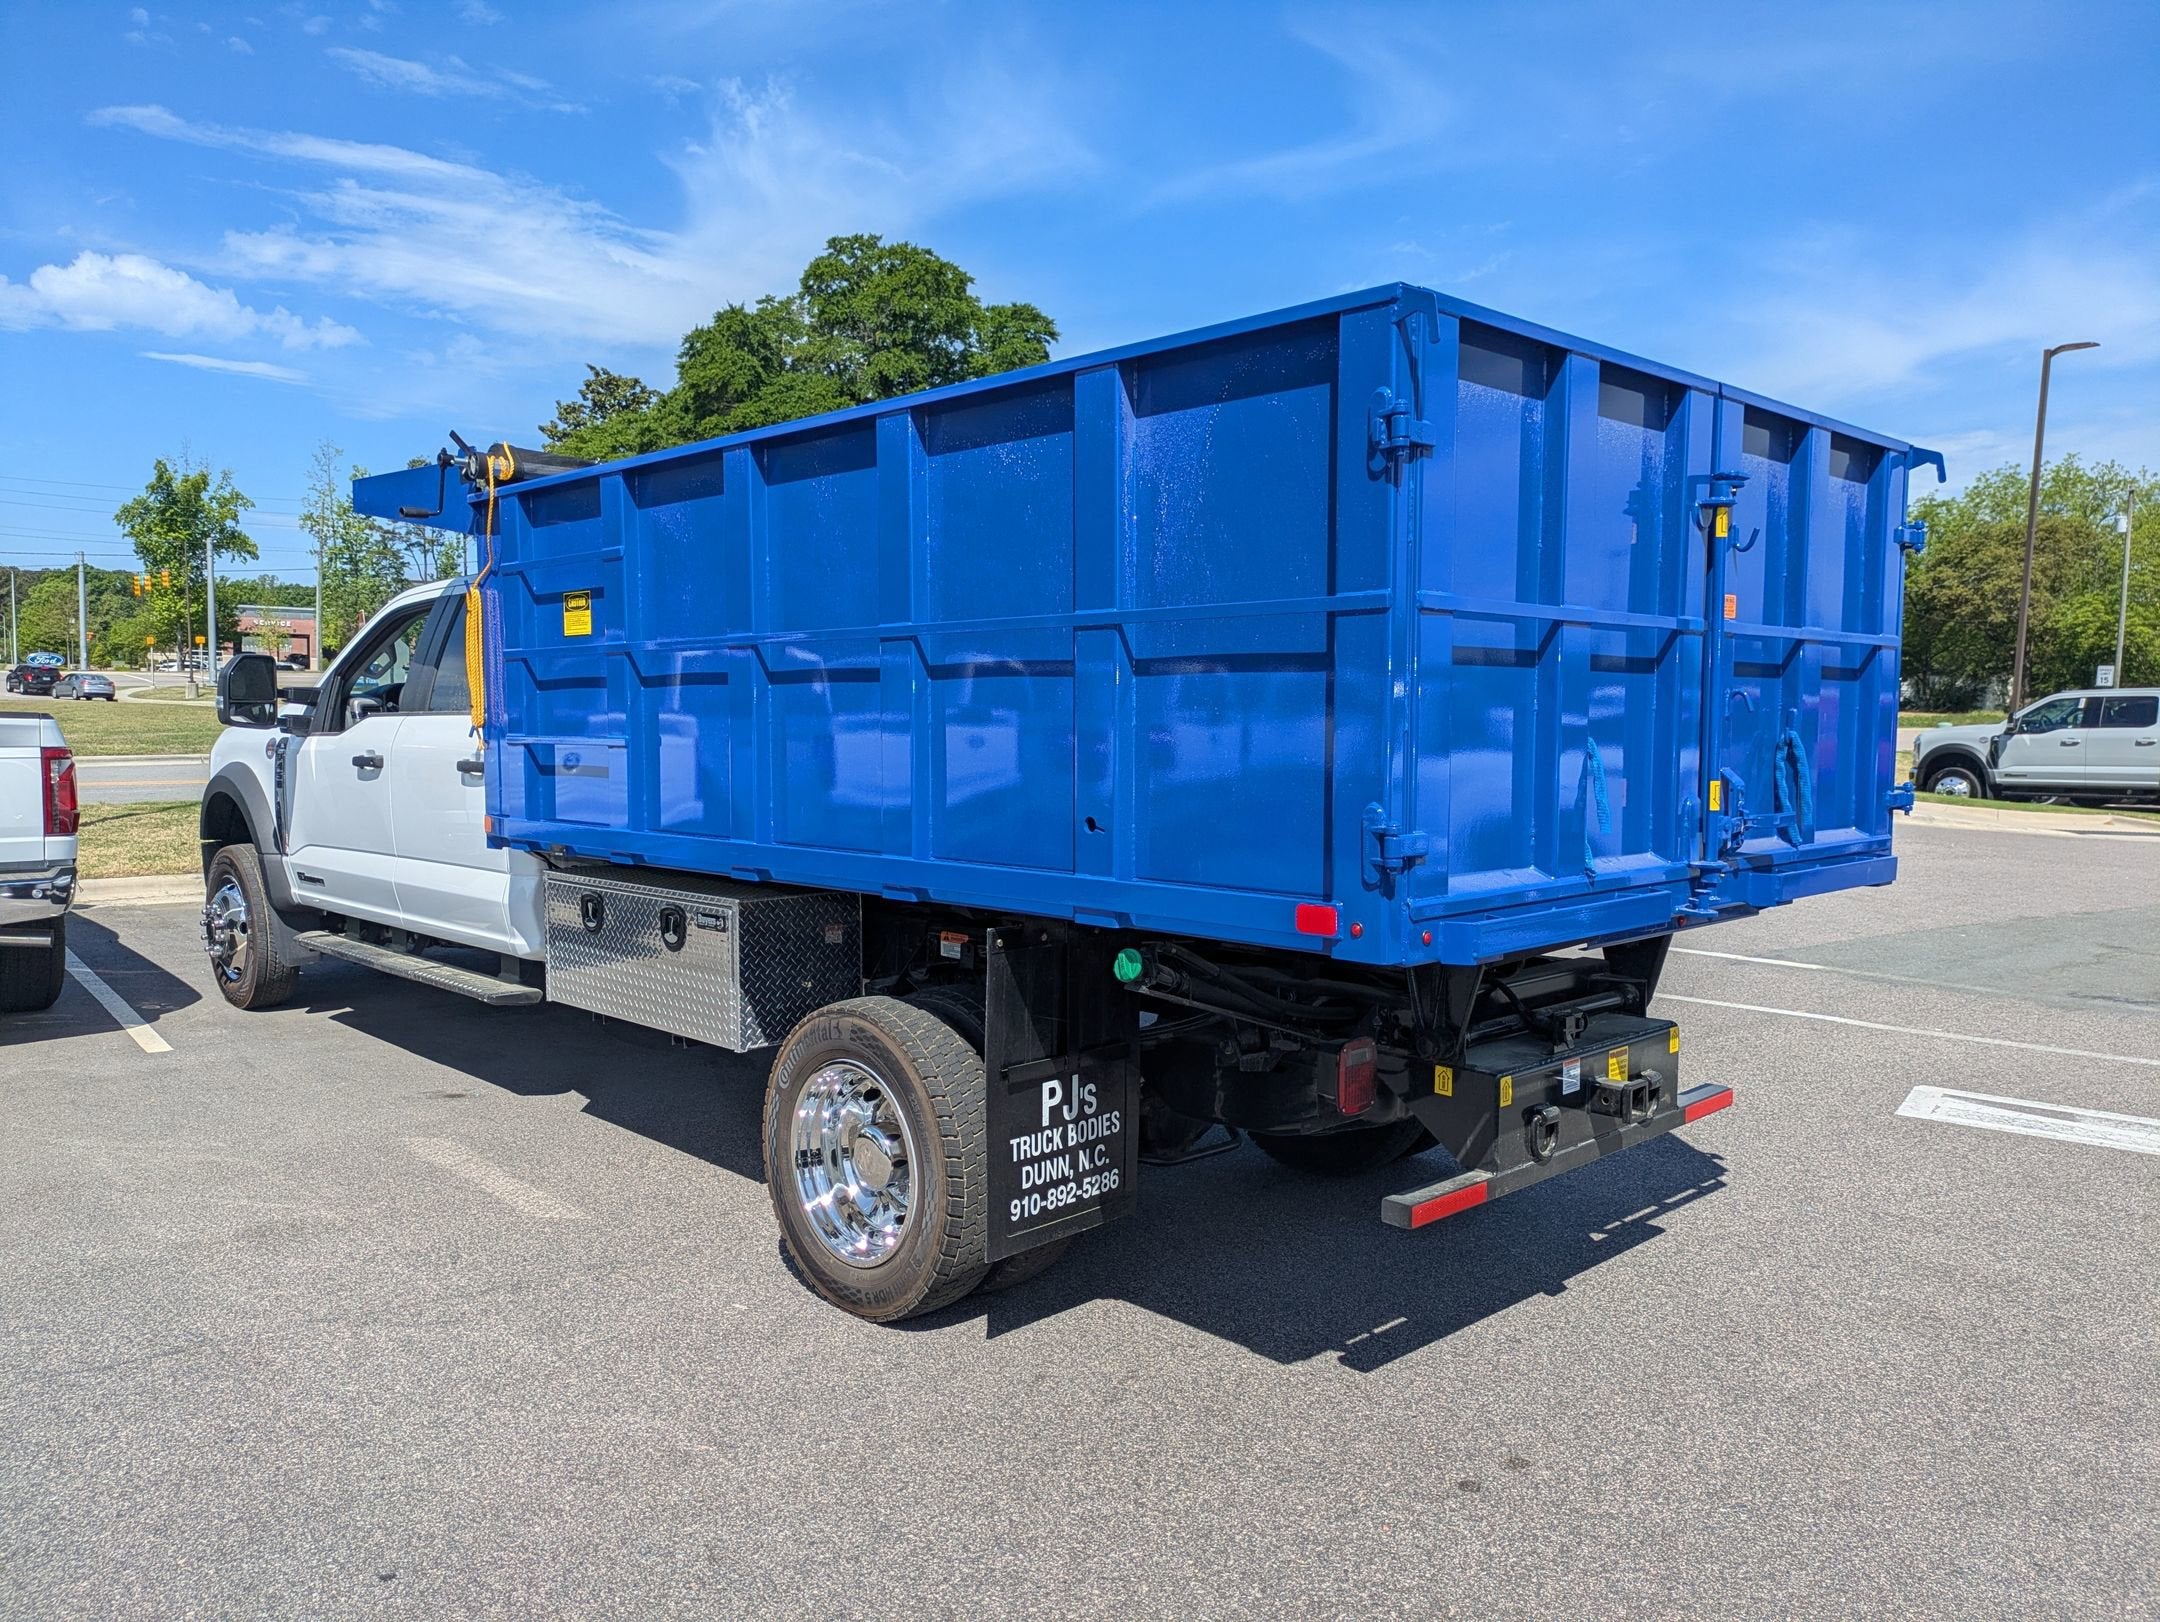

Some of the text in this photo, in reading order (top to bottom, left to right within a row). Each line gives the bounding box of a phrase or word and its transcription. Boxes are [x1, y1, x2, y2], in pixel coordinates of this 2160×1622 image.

[34, 655, 57, 664] Ford
[1010, 1111, 1120, 1162] TRUCK BODIES
[1021, 1144, 1109, 1190] DUNN, N.C.
[1010, 1168, 1119, 1222] 910-892-5286
